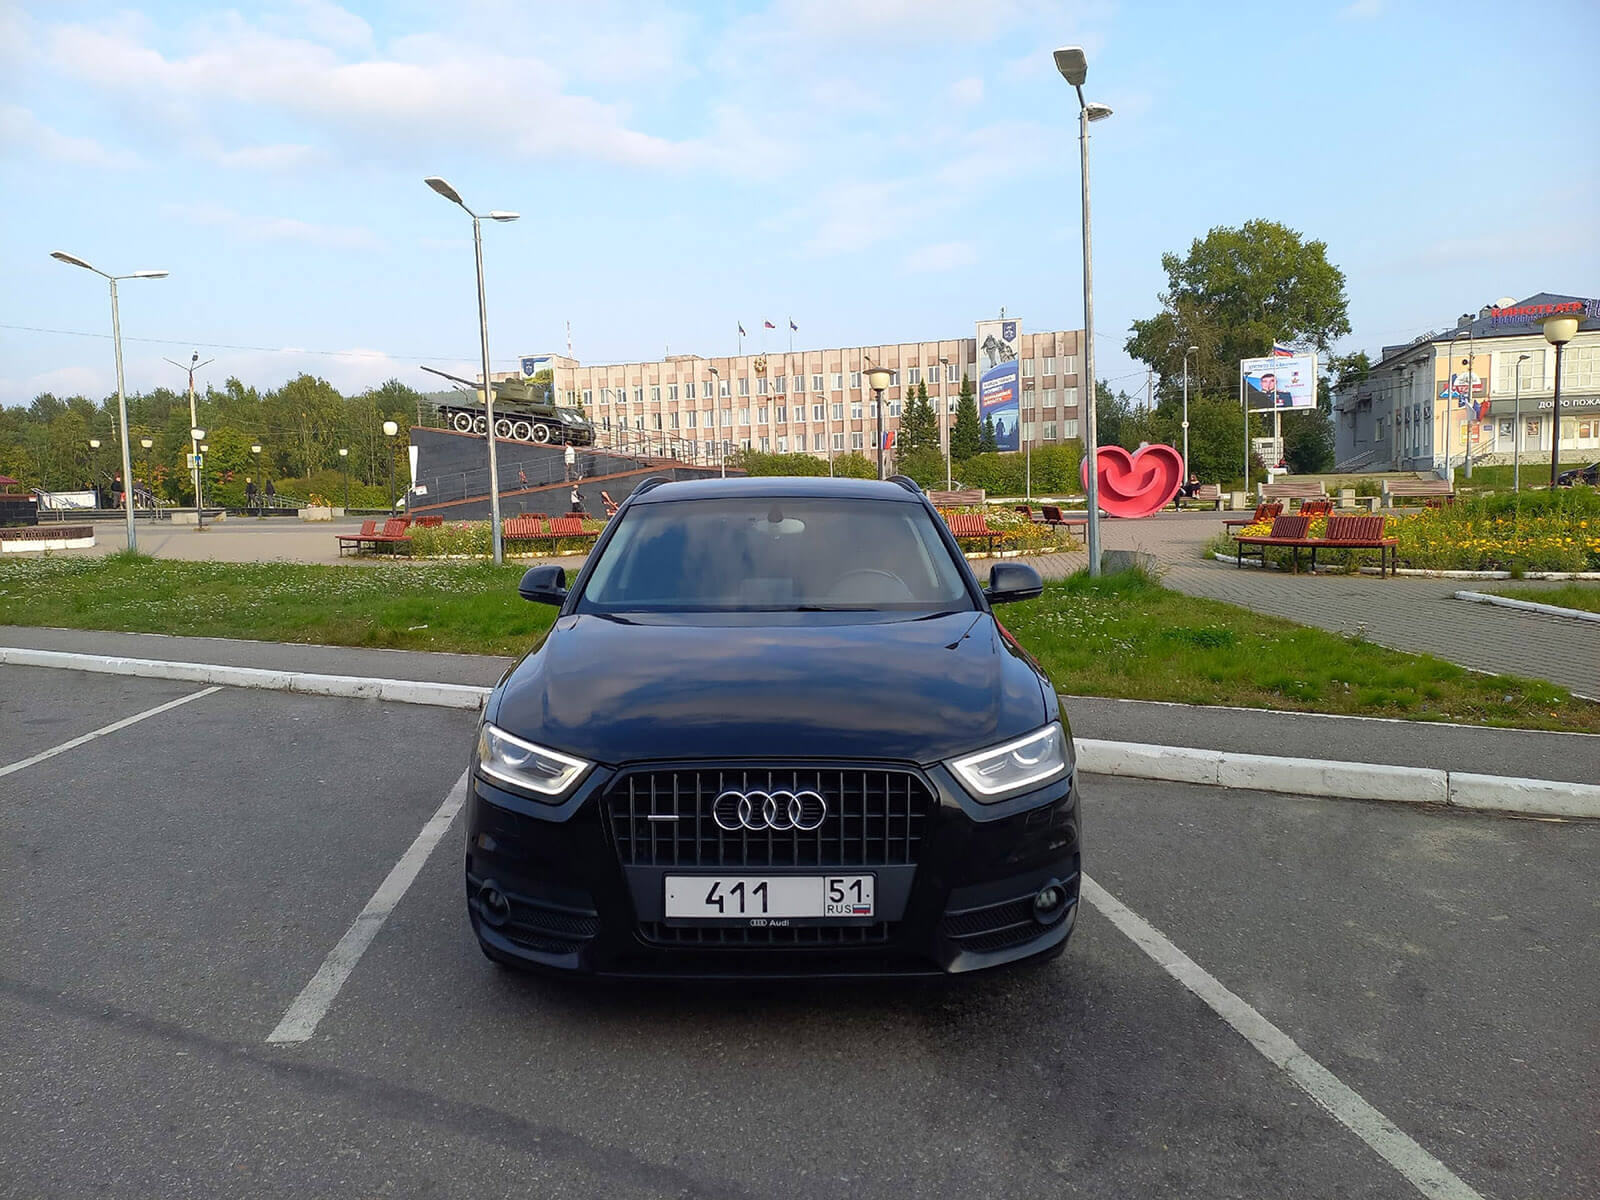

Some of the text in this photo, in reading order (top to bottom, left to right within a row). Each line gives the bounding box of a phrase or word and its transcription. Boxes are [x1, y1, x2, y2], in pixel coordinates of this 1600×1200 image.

[1491, 301, 1583, 318] КИНОТЕАТР
[1538, 400, 1570, 409] ДОО
[705, 879, 862, 913] 411 51
[827, 904, 851, 914] RUS
[769, 919, 790, 927] Audi
